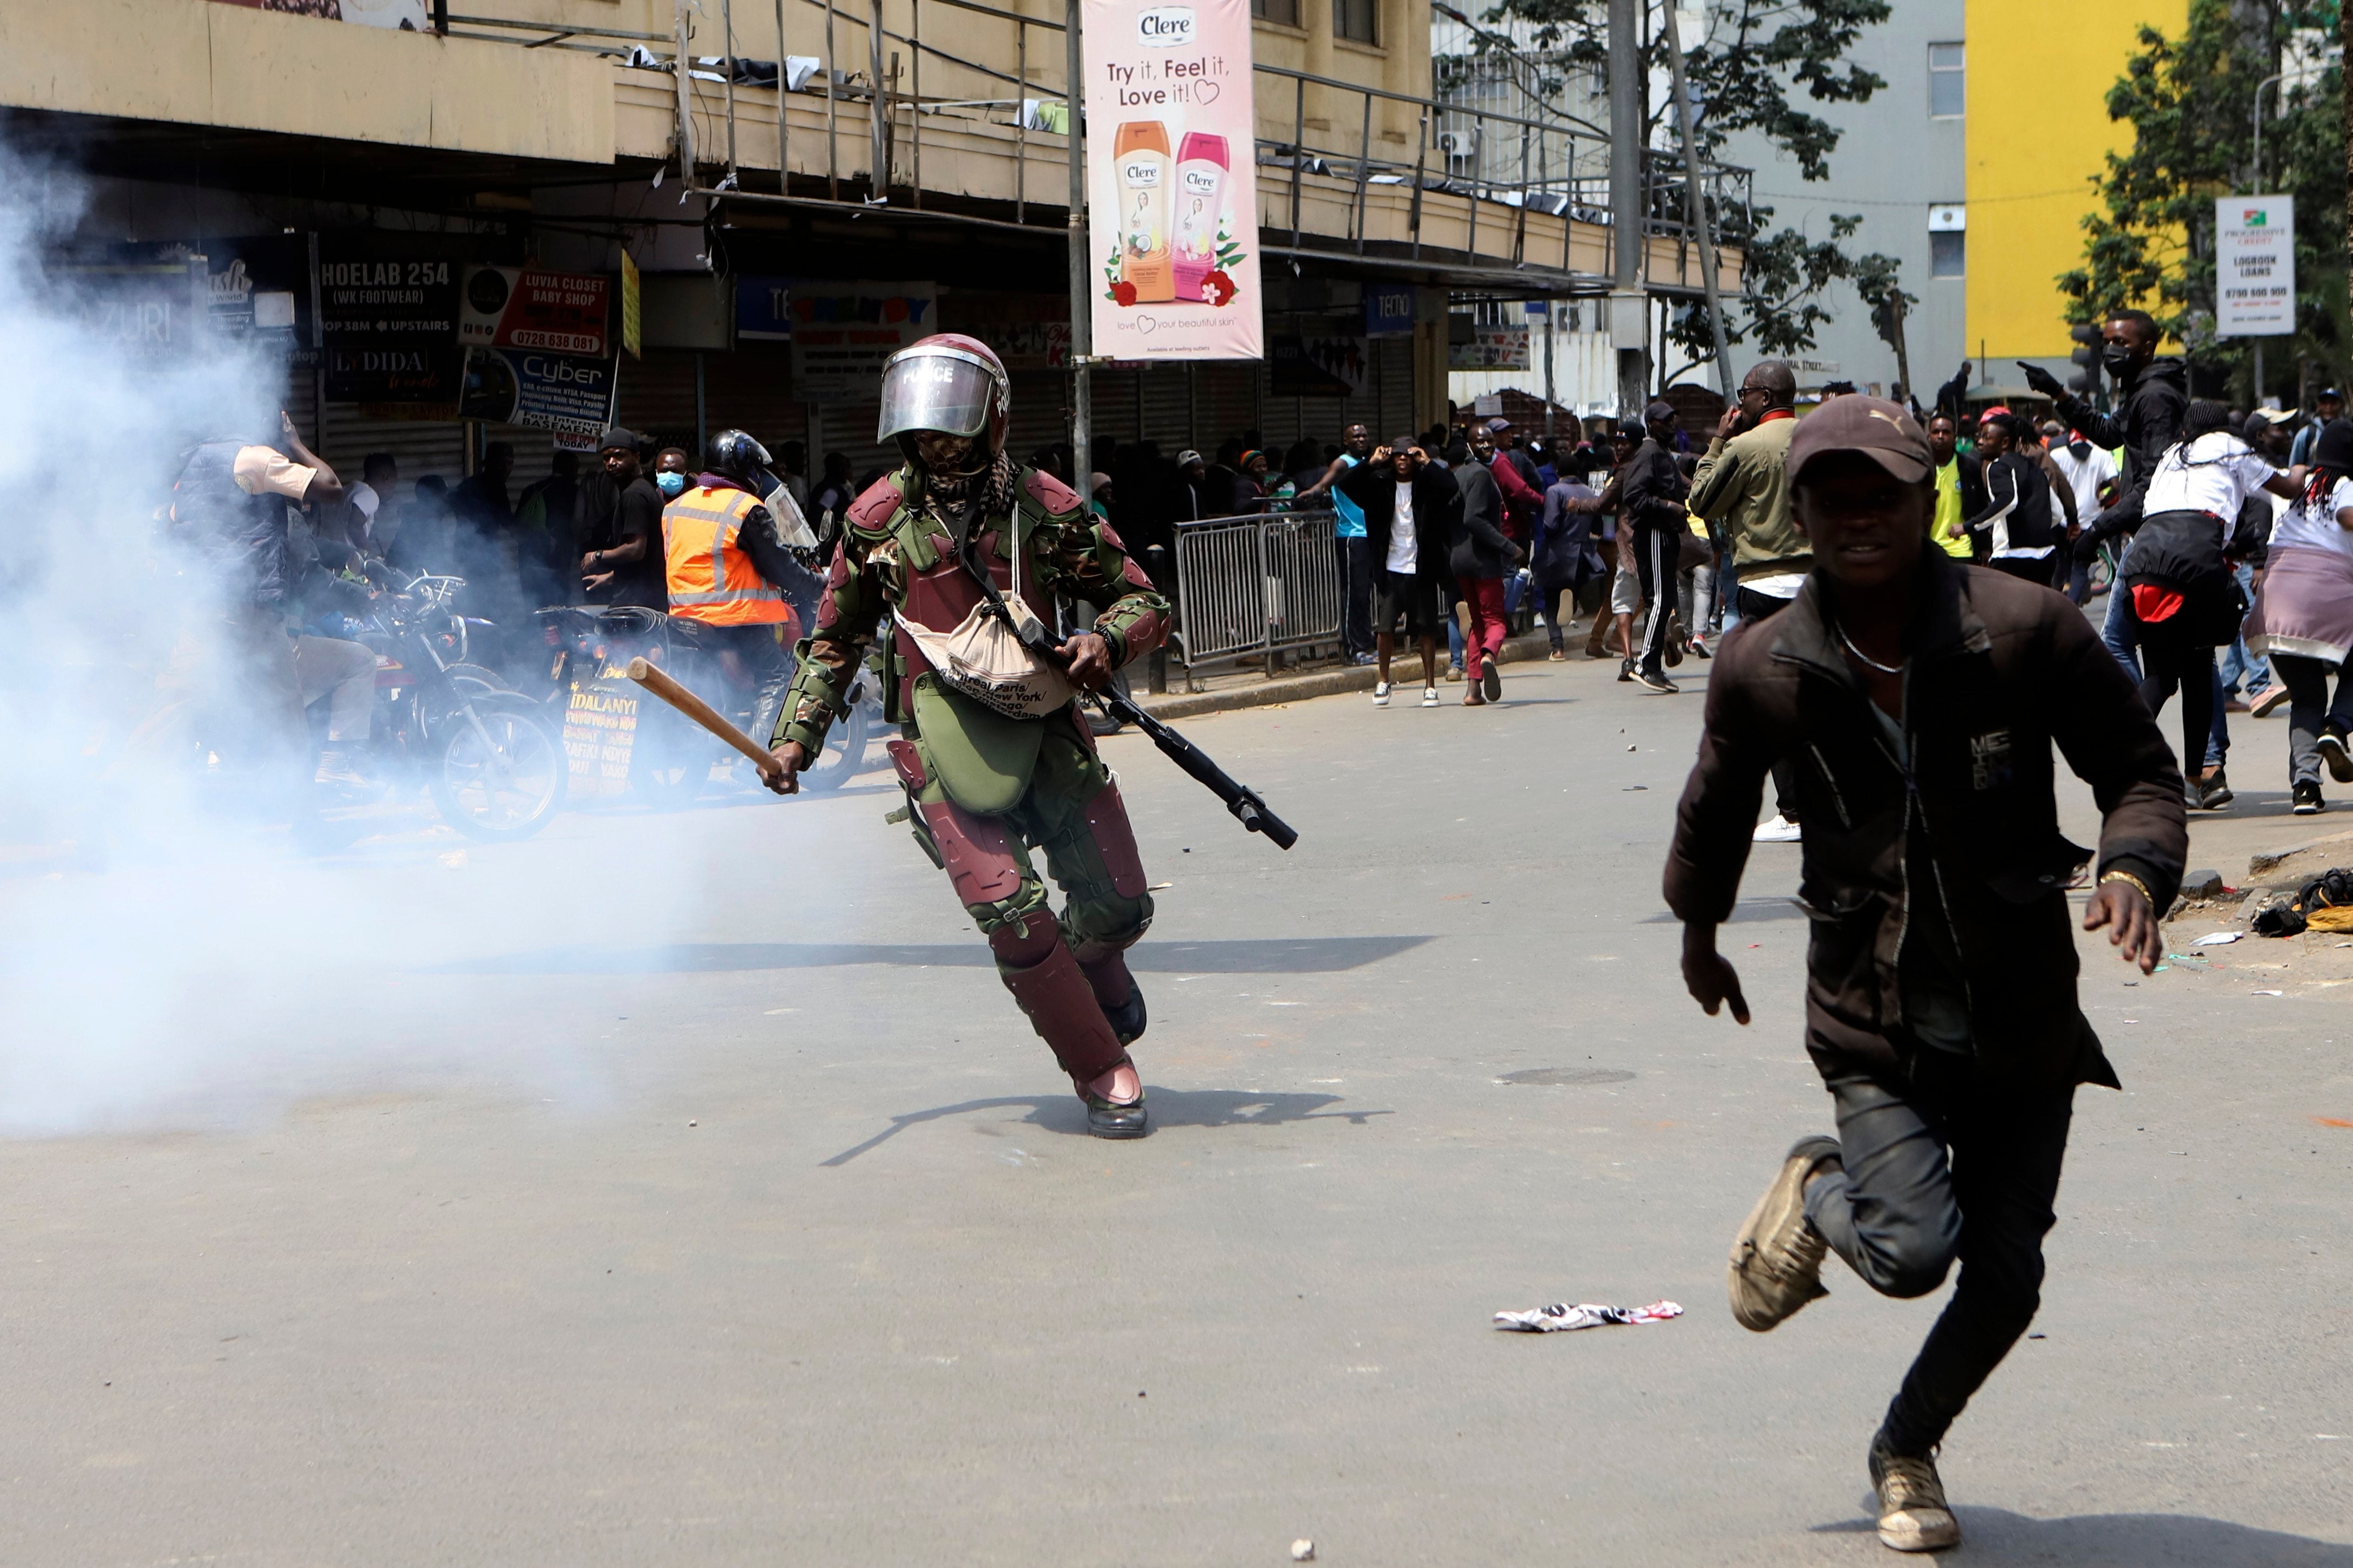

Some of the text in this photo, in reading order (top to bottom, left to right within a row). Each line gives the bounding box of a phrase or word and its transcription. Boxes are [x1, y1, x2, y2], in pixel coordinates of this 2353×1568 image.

[1141, 16, 1190, 35] Clere
[1107, 57, 1229, 85] Try it, Feel it,
[1120, 84, 1189, 106] Love it!
[1127, 166, 1157, 178] Clere
[1187, 173, 1214, 186] Clere
[2234, 255, 2276, 266] LOGBOOK
[322, 262, 449, 286] HOELAB 254
[2241, 268, 2270, 277] LOANS
[526, 275, 605, 292] LUVIA CLOSET
[333, 289, 424, 305] (WK FOOTWEAR)
[532, 290, 595, 307] BABY SHOP
[1379, 294, 1408, 317] TECNO
[324, 321, 343, 331] OP
[391, 320, 450, 331] UPSTAIRS
[1117, 322, 1135, 330] love
[1157, 321, 1176, 329] your
[1178, 318, 1217, 328] beautiful
[518, 331, 593, 349] 0728 638 081
[523, 355, 602, 385] Cyber
[1802, 360, 1822, 371] STREET
[903, 366, 954, 384] POICE
[580, 390, 606, 401] Passport
[524, 411, 603, 427] Fast Internet
[580, 410, 602, 419] Binding
[523, 418, 603, 436] BASEMENT
[556, 433, 595, 444] WE ARE OPEN
[559, 440, 588, 449] TODAY
[1015, 691, 1046, 702] York/
